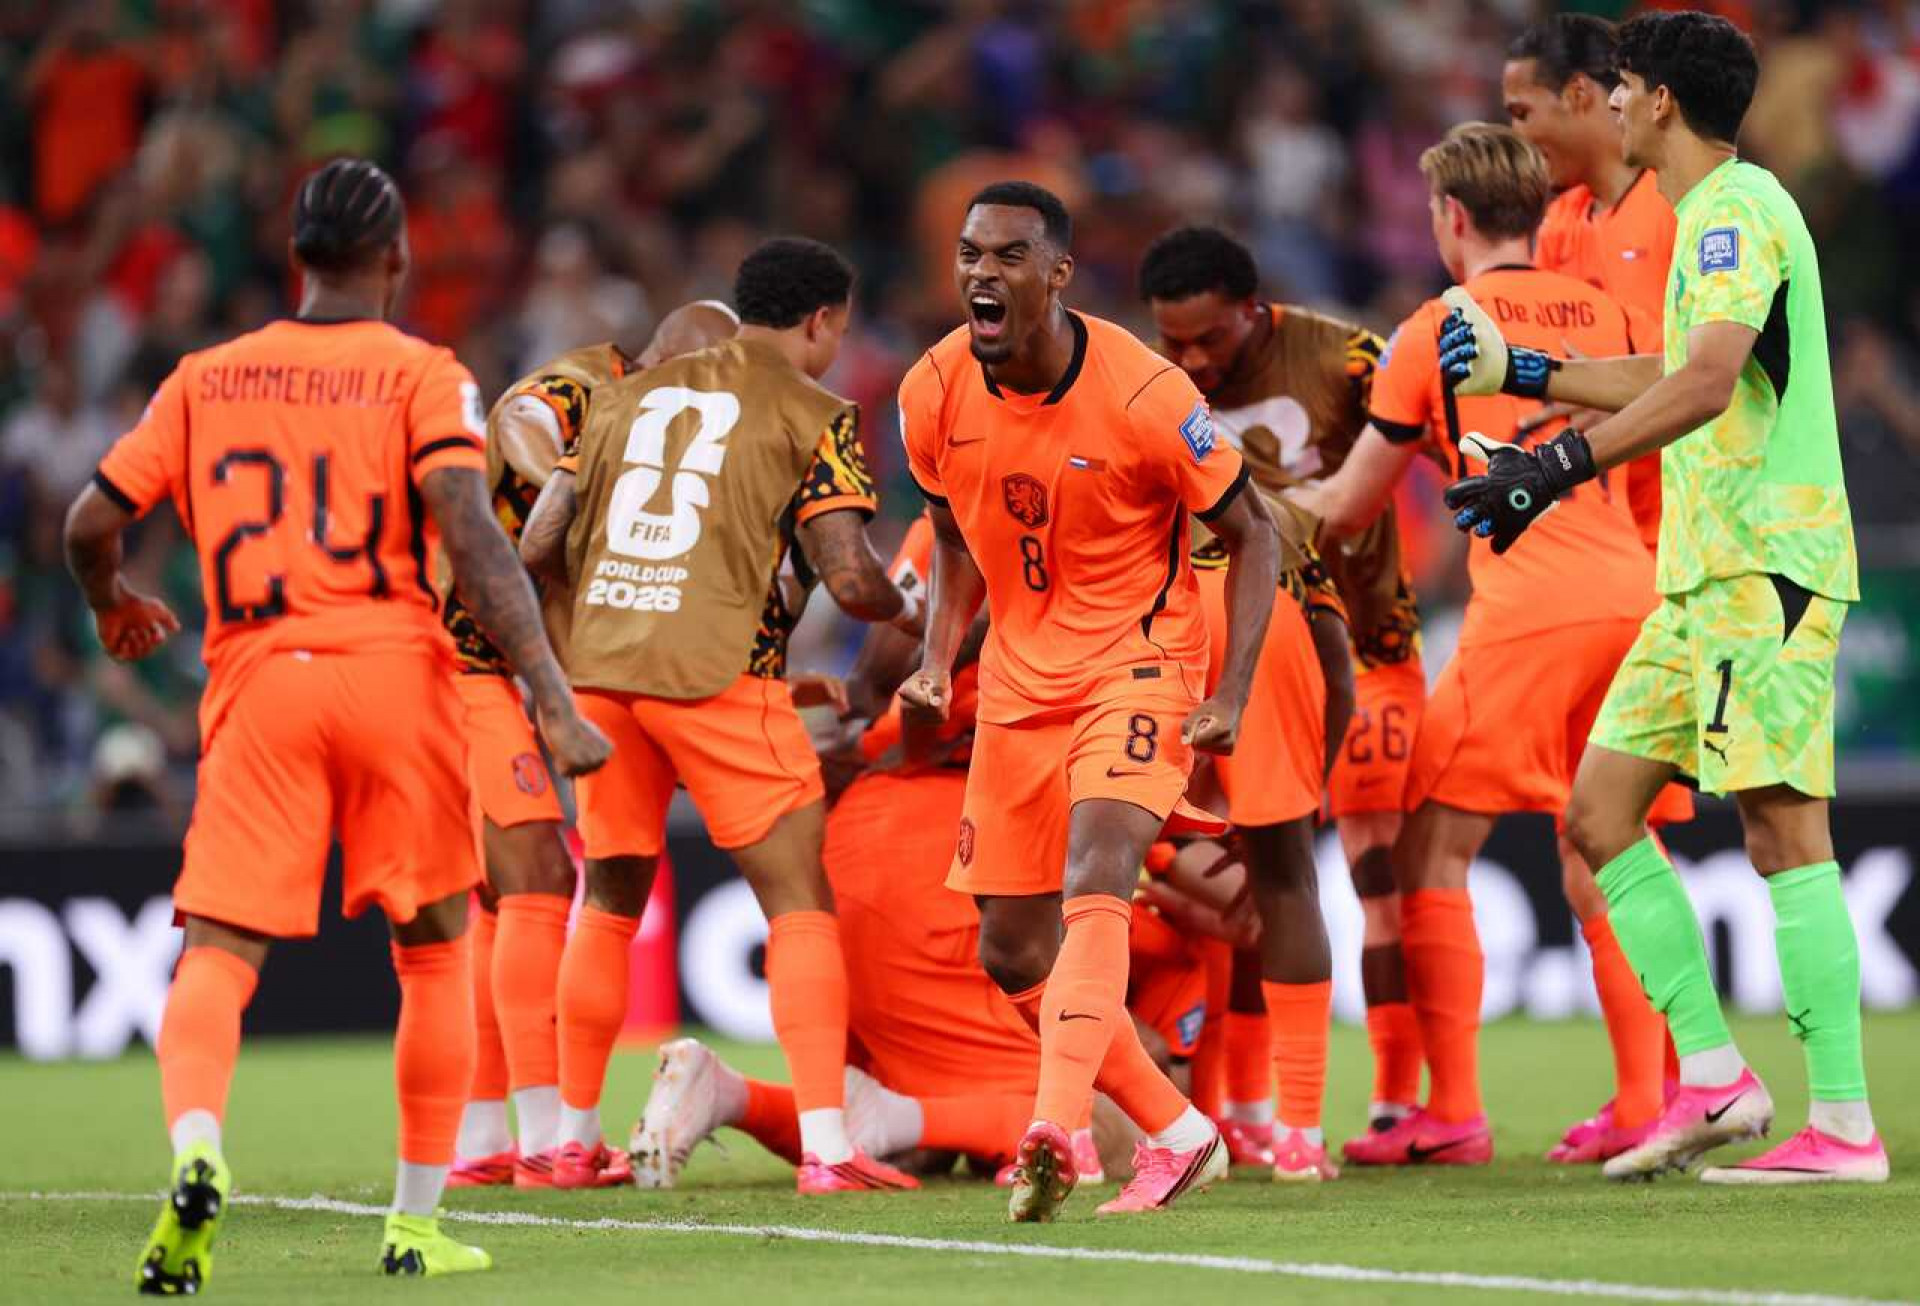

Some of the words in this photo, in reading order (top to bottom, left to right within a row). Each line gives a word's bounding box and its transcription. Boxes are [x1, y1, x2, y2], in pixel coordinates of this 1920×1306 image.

[1493, 296, 1529, 322] De
[1535, 301, 1596, 328] JONG
[200, 366, 409, 406] SUMMERVILLE
[212, 450, 389, 622] 24
[629, 521, 671, 542] FIFA
[1019, 534, 1049, 593] 8
[585, 579, 682, 613] 2026
[1706, 659, 1733, 734] 1
[1125, 713, 1158, 764] 8
[1347, 705, 1408, 764] 26
